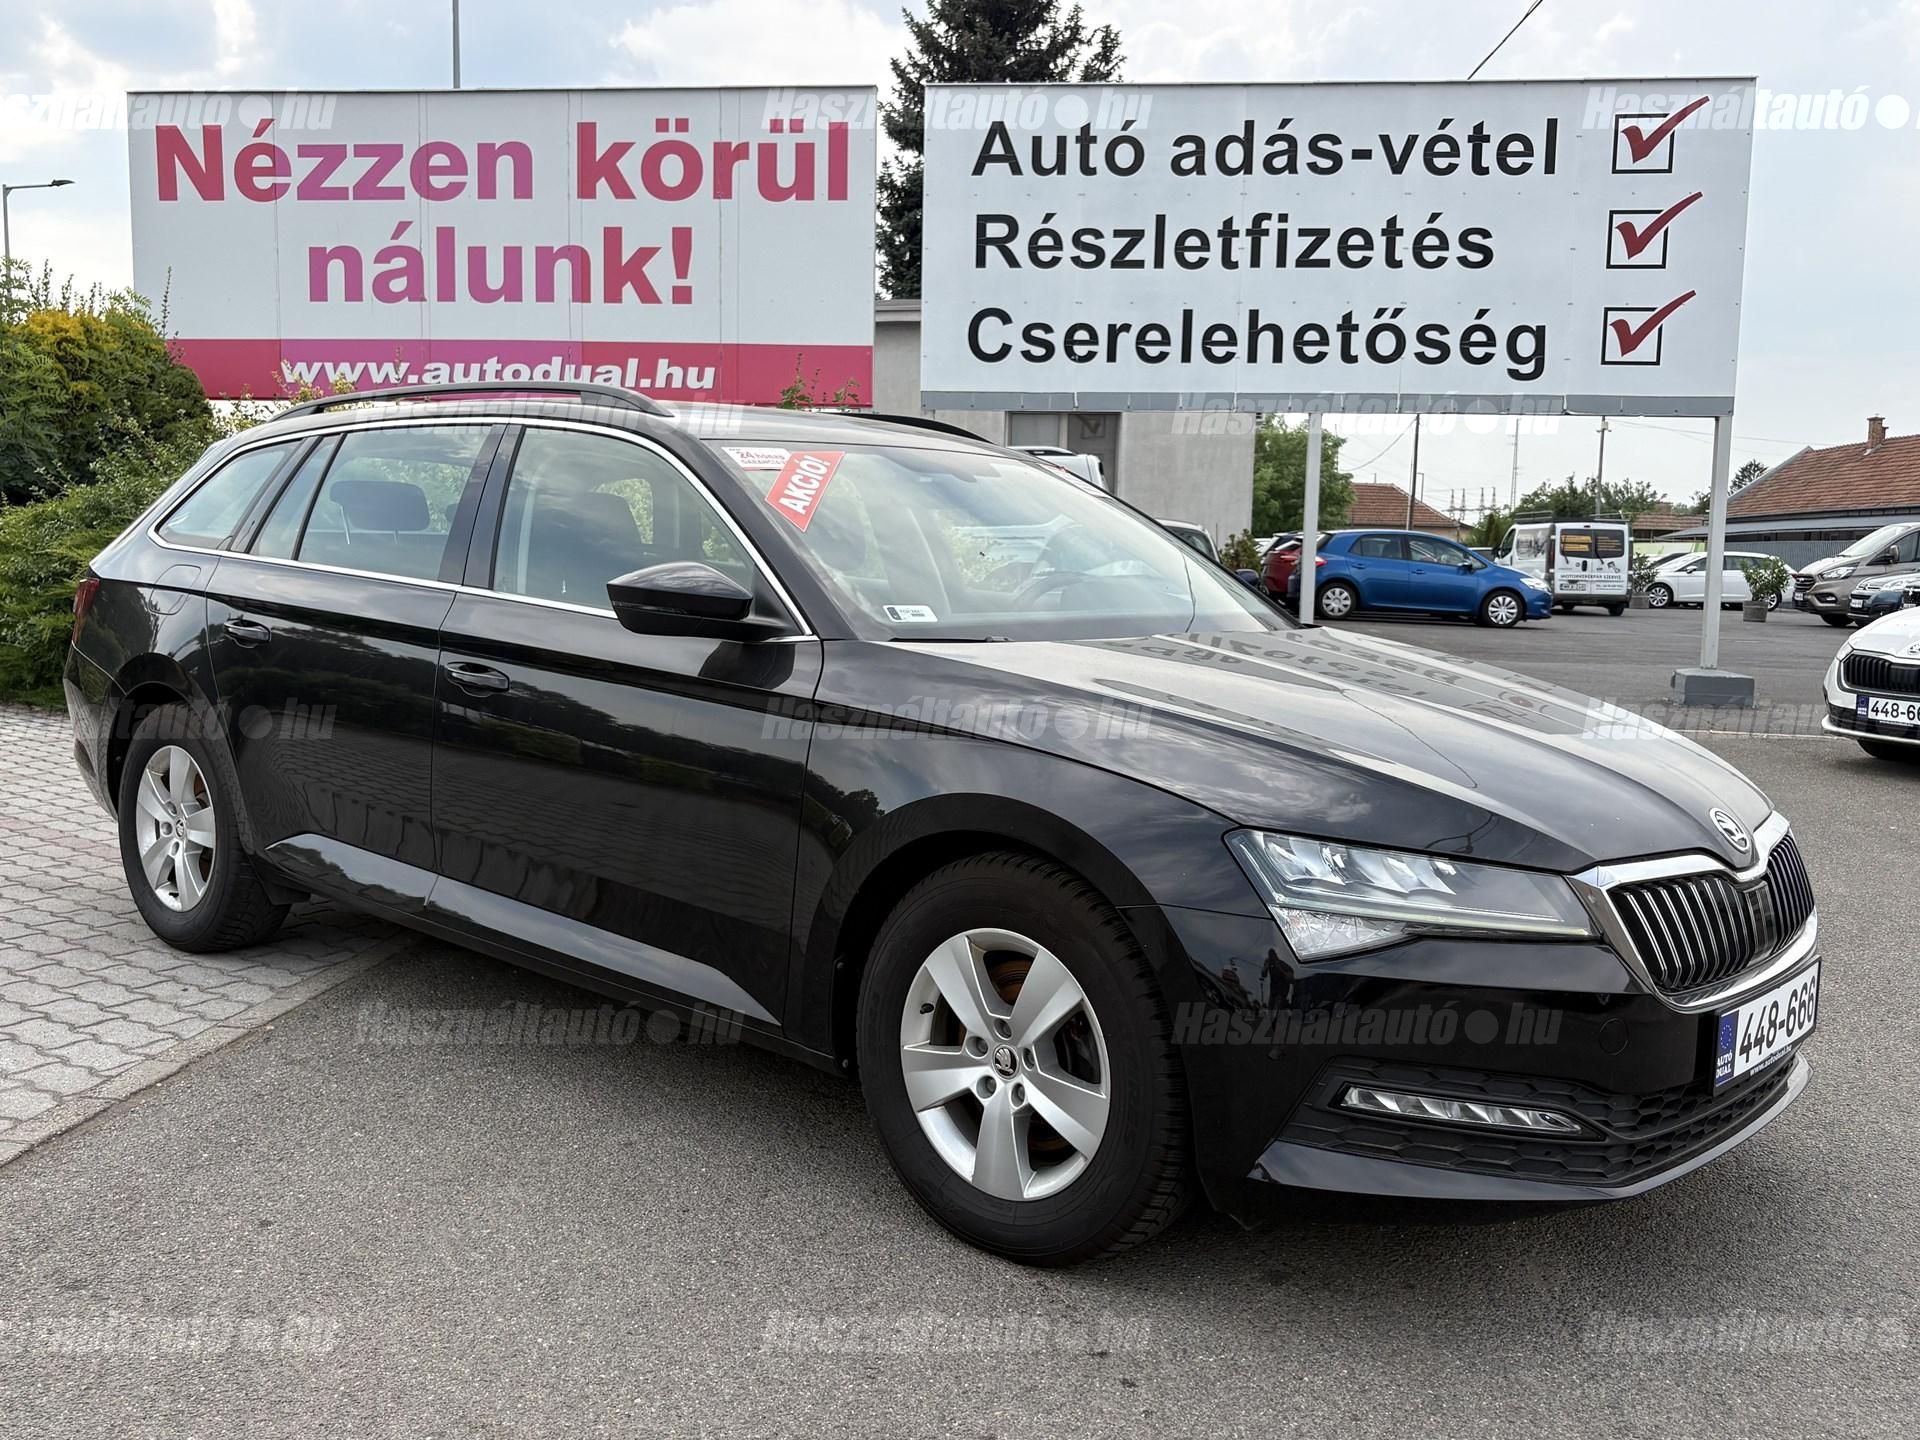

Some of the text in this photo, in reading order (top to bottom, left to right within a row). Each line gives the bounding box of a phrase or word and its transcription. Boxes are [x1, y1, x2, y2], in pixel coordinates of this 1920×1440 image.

[157, 118, 848, 202] Nézzen körül
[971, 117, 1559, 177] Autó adás-vétel
[309, 222, 692, 304] nálunk!
[974, 212, 1494, 270] Részletfizetés
[281, 356, 716, 389] www.autodual.hu
[967, 307, 1547, 382] Cserelehetőség
[779, 455, 831, 515] AKCIÓ!
[1739, 975, 1816, 1063] 448-666
[1717, 1049, 1732, 1067] AUTÓ
